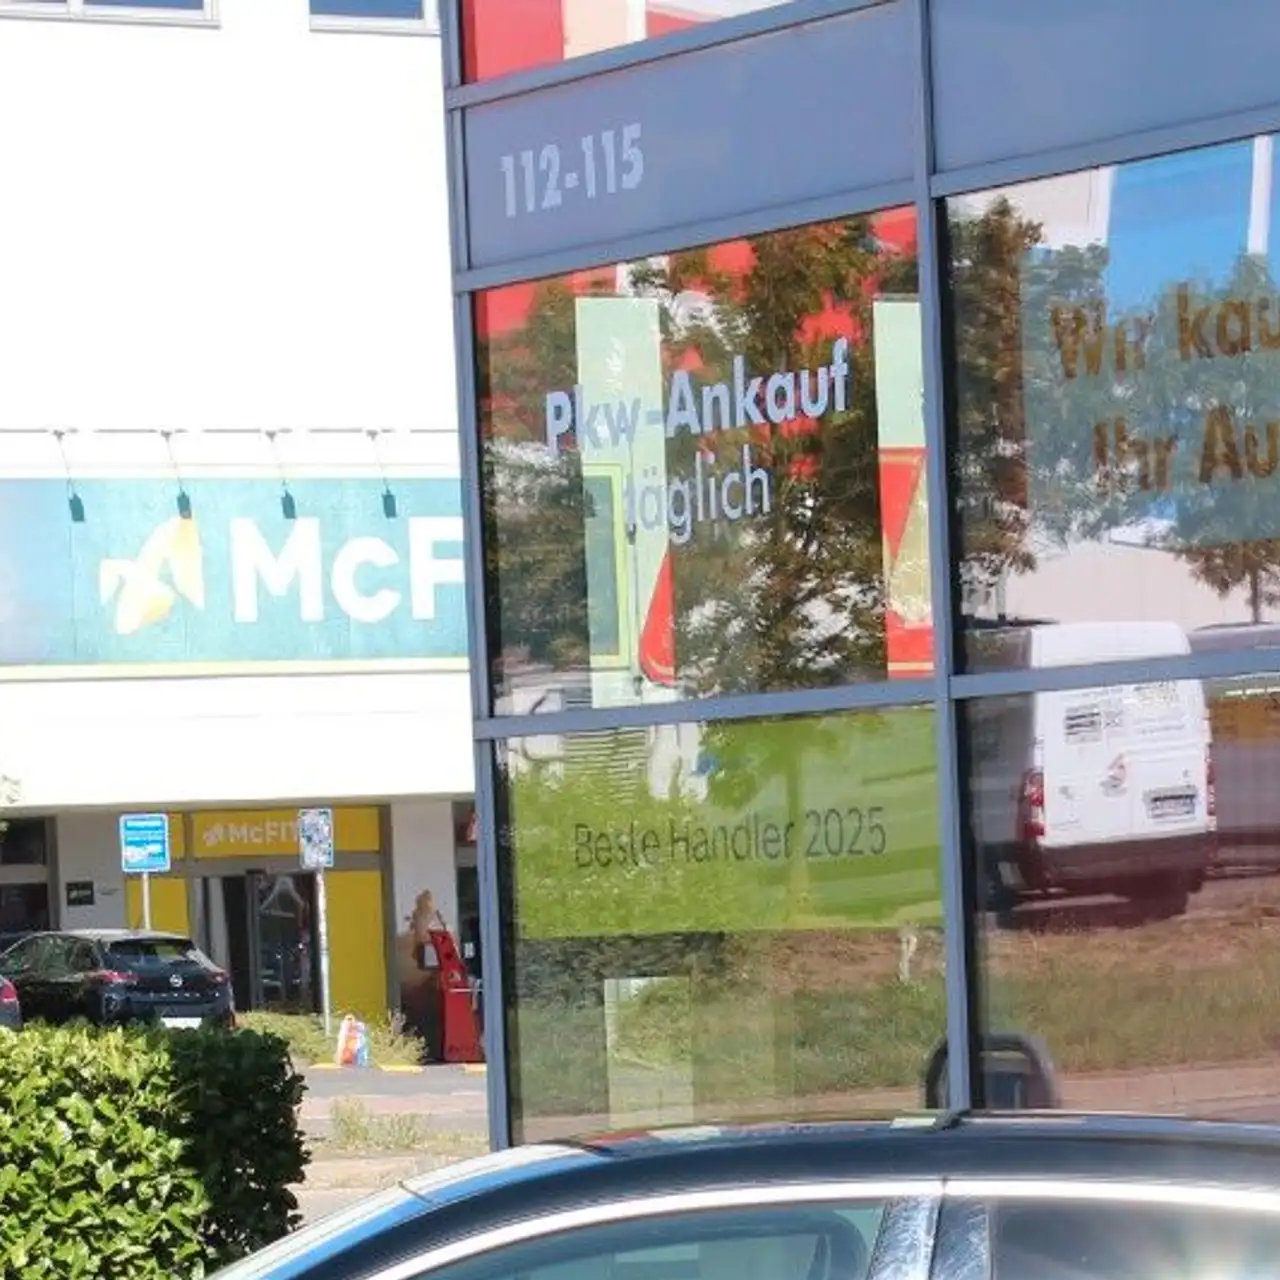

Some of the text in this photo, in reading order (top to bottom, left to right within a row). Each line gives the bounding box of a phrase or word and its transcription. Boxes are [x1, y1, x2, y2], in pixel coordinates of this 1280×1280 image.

[499, 122, 644, 218] 112-115
[545, 336, 850, 452] Pkw-Ankauf
[573, 822, 662, 869] Beste
[805, 806, 888, 858] 2025
